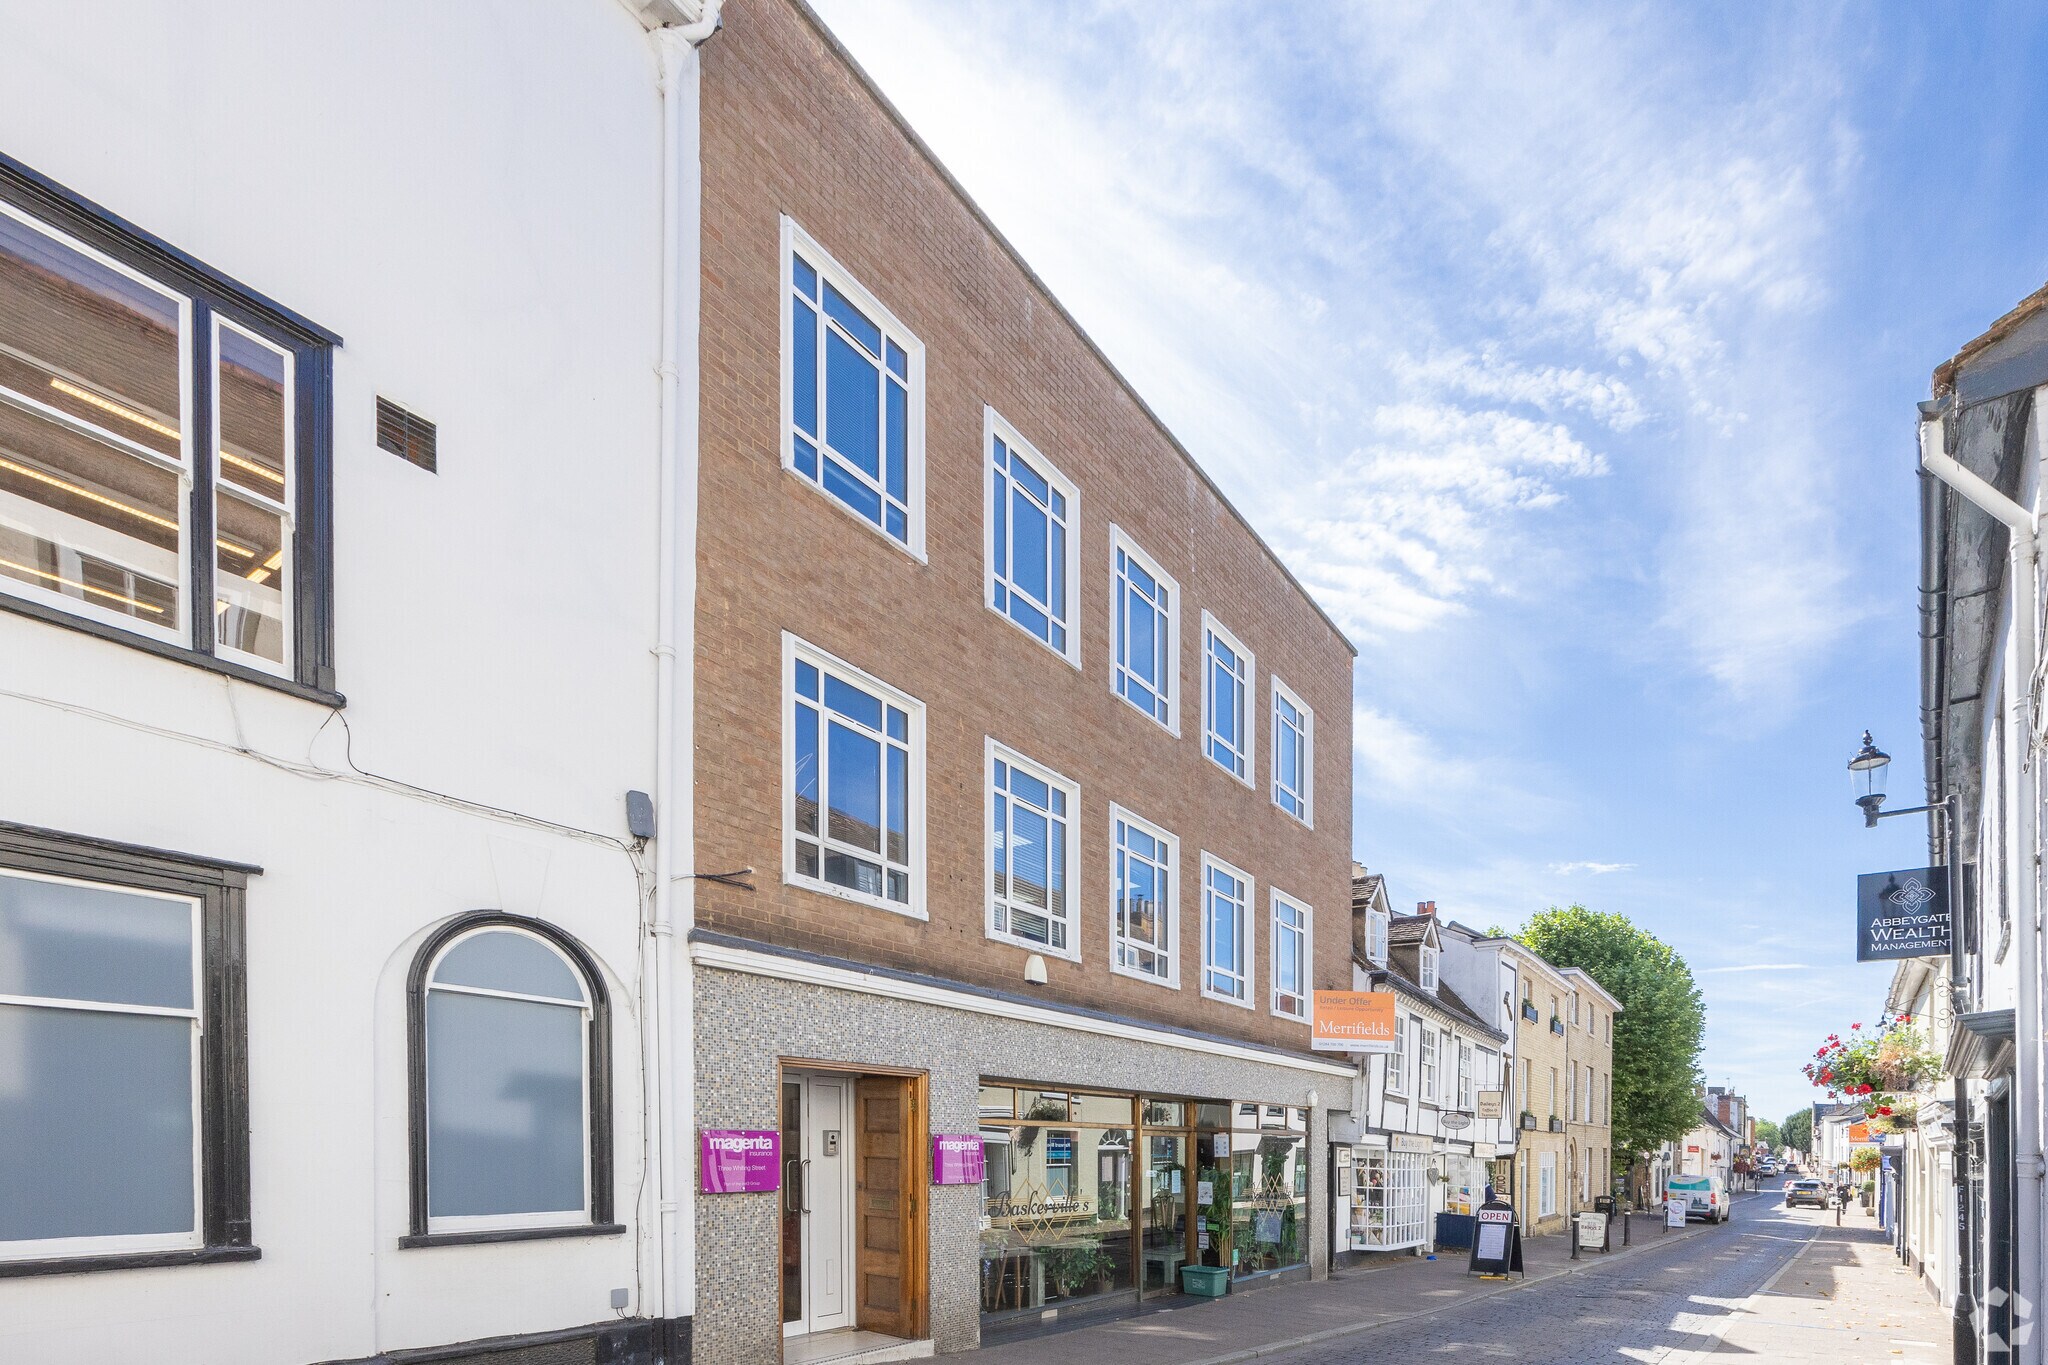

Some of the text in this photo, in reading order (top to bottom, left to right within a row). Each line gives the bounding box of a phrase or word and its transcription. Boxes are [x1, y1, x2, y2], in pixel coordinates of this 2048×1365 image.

[1871, 913, 1950, 927] ABBEYGATE
[1871, 926, 1950, 941] WEALTH
[1320, 995, 1372, 1006] Under Offer
[1320, 1020, 1390, 1036] Merrifields
[709, 1136, 773, 1152] magenta
[940, 1140, 980, 1152] magenta
[1481, 1212, 1509, 1221] OPEN
